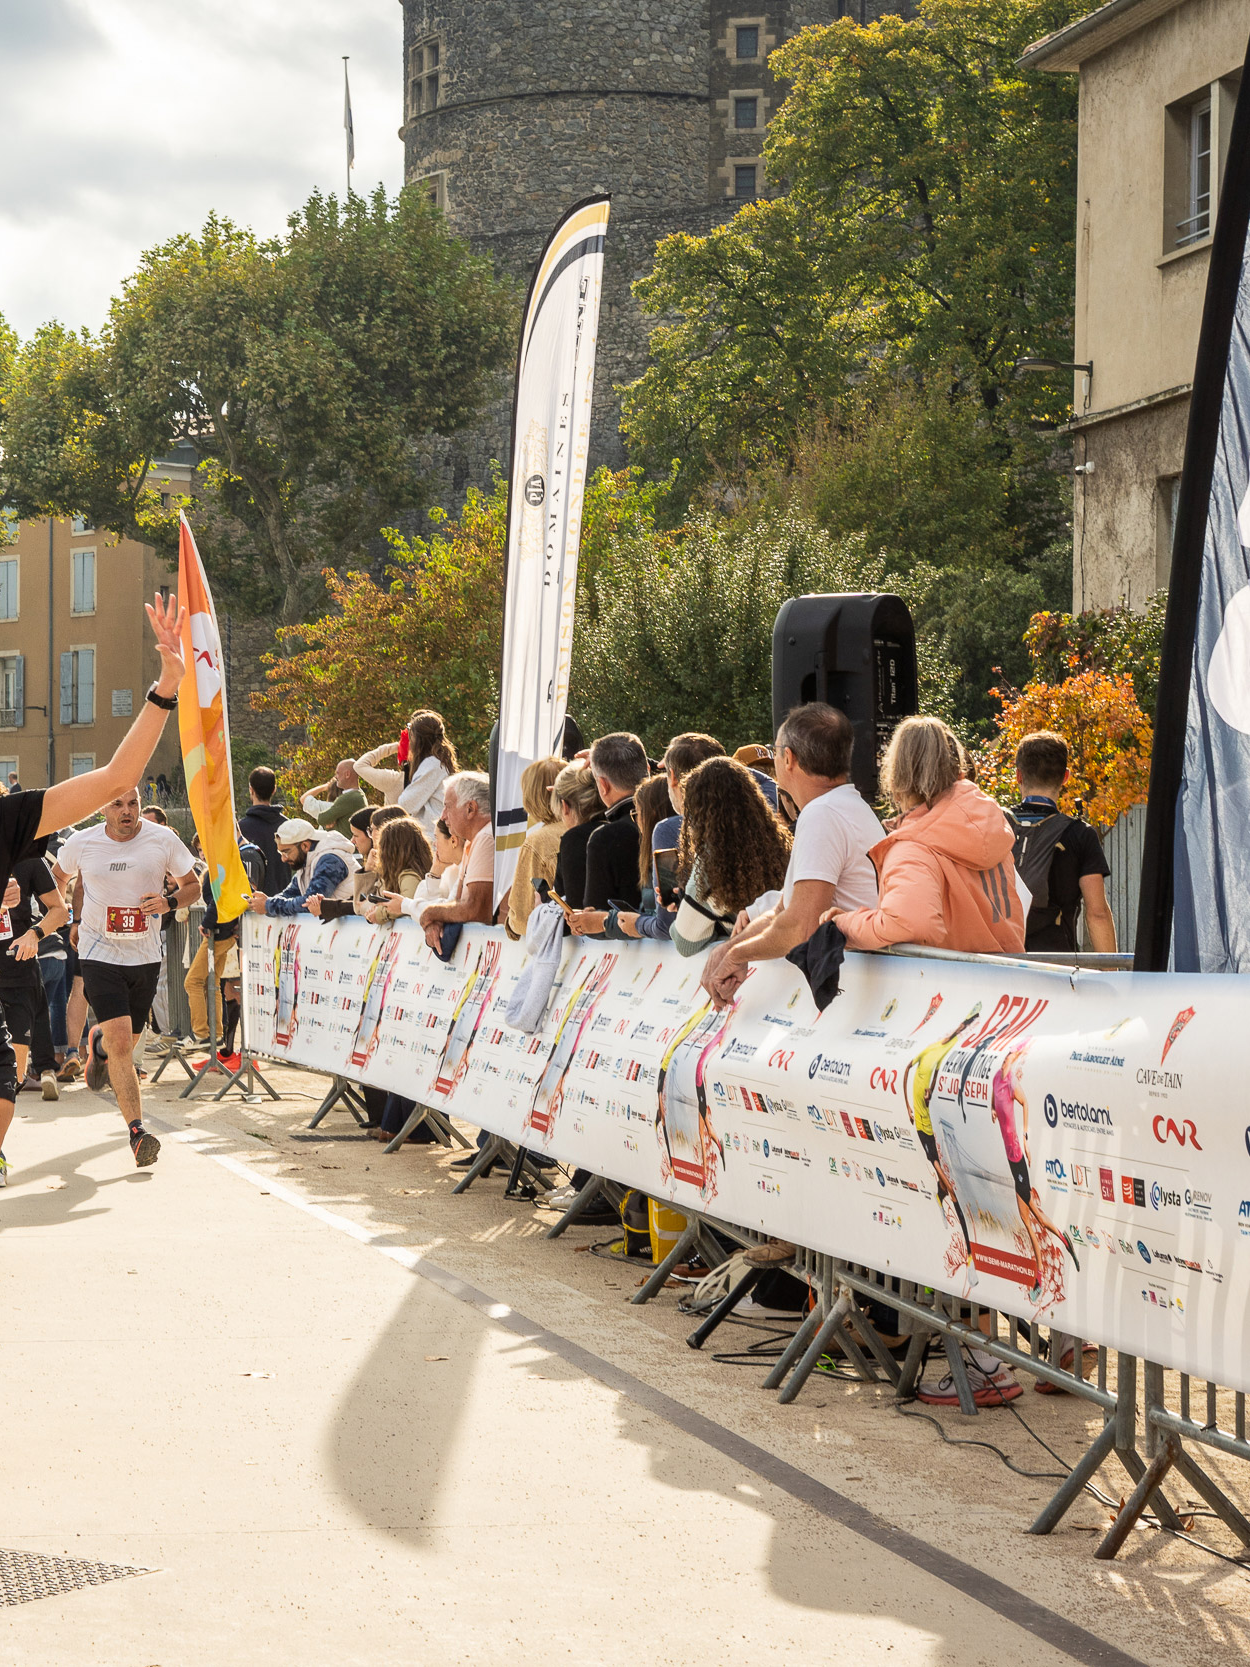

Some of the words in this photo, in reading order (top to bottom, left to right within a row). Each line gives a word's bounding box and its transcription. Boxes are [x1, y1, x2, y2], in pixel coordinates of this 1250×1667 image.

[122, 915, 135, 928] 39
[961, 994, 1049, 1052] SEMI
[768, 1049, 795, 1071] CNR
[870, 1066, 897, 1095] CNR
[1136, 1068, 1157, 1086] CAVE
[1163, 1073, 1183, 1090] TAIN
[1060, 1098, 1113, 1126] bertolami
[1152, 1114, 1203, 1152] CNR
[1045, 1158, 1067, 1179] ATOL
[1070, 1163, 1091, 1188] LDT
